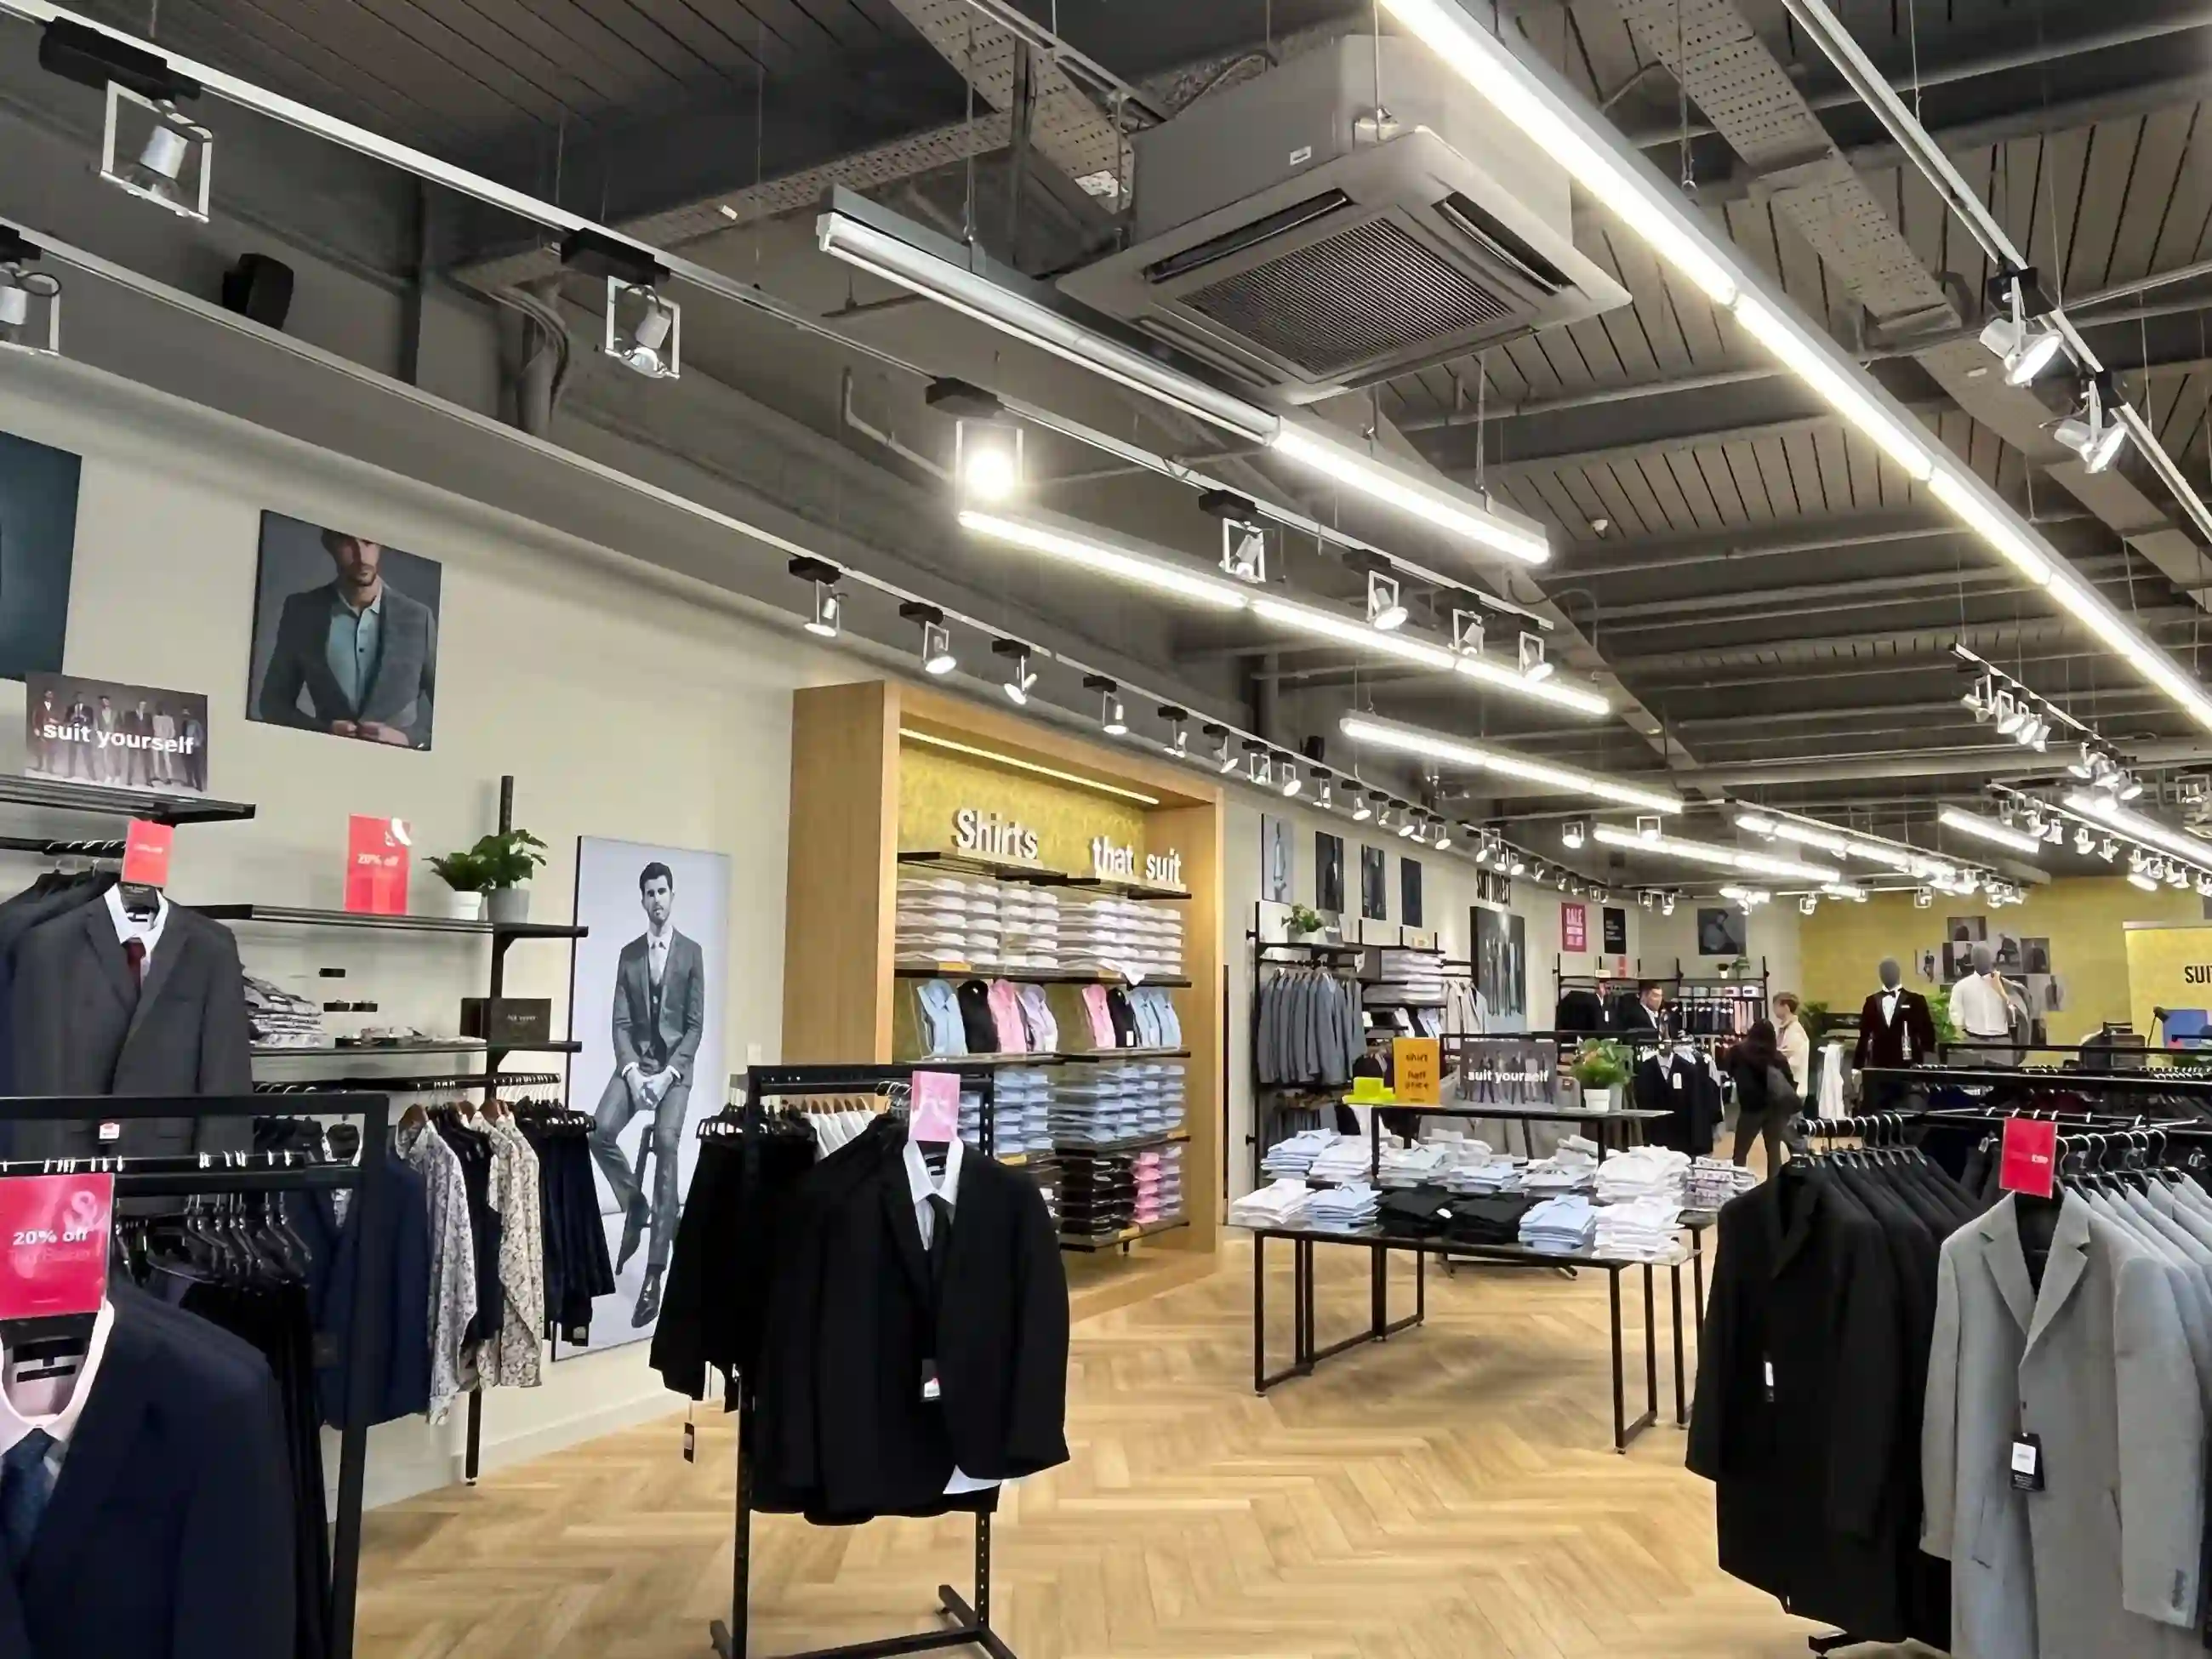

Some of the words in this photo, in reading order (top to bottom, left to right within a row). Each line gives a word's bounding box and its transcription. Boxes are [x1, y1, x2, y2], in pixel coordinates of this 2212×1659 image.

[43, 722, 92, 743] suit
[95, 729, 195, 755] yourself
[955, 807, 1039, 861] Shirts
[1092, 835, 1135, 875] that
[1145, 847, 1183, 887] suit
[2184, 966, 2212, 983] SUI
[1468, 1069, 1491, 1082] suit
[1495, 1069, 1549, 1085] yourself
[13, 1228, 58, 1246] 20%
[62, 1226, 89, 1243] off
